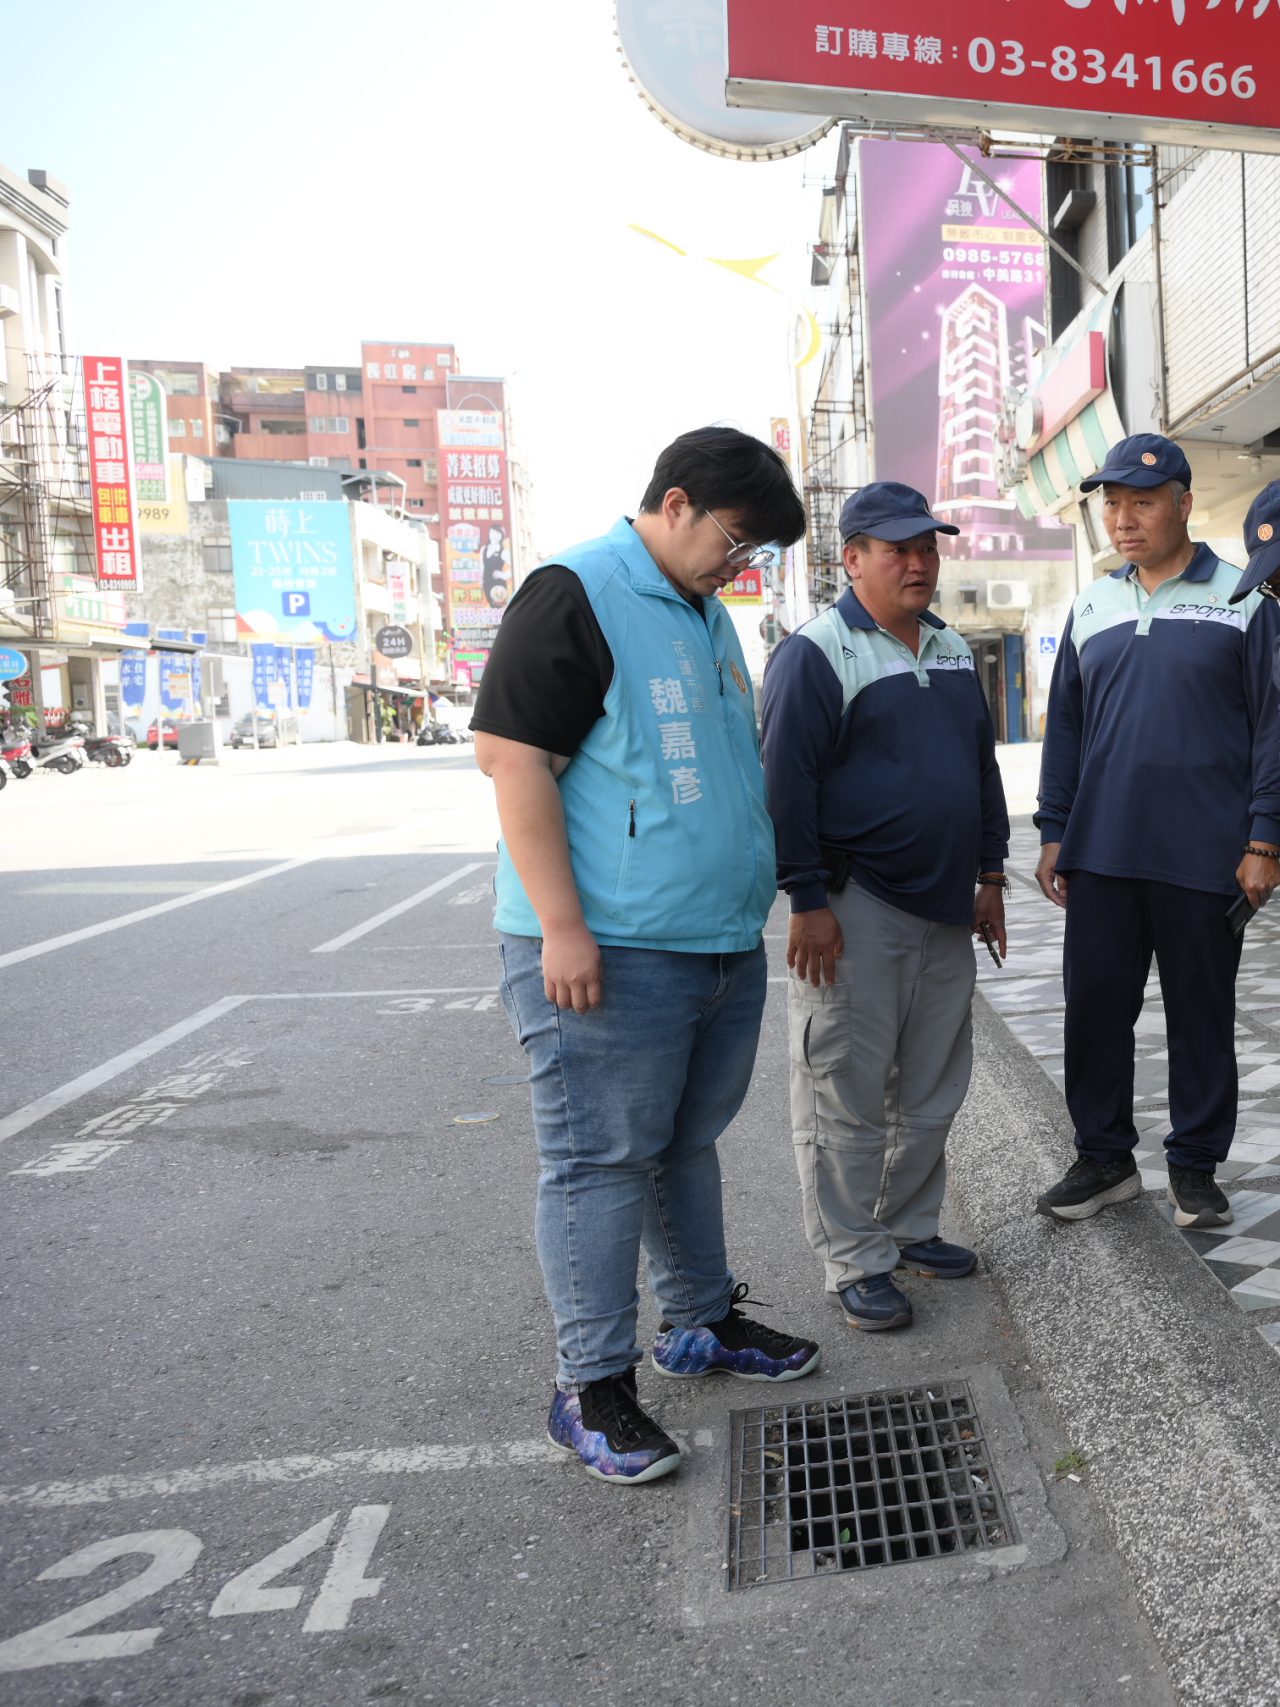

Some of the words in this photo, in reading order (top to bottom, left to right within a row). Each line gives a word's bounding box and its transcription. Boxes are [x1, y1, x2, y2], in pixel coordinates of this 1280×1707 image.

[968, 36, 1258, 100] 03-8341666
[89, 362, 126, 484] 上格電動車
[101, 527, 132, 575] 出租
[247, 540, 337, 565] TWINS
[1169, 603, 1240, 618] SPORT
[376, 994, 499, 1015] 34
[0, 1503, 392, 1673] 24
